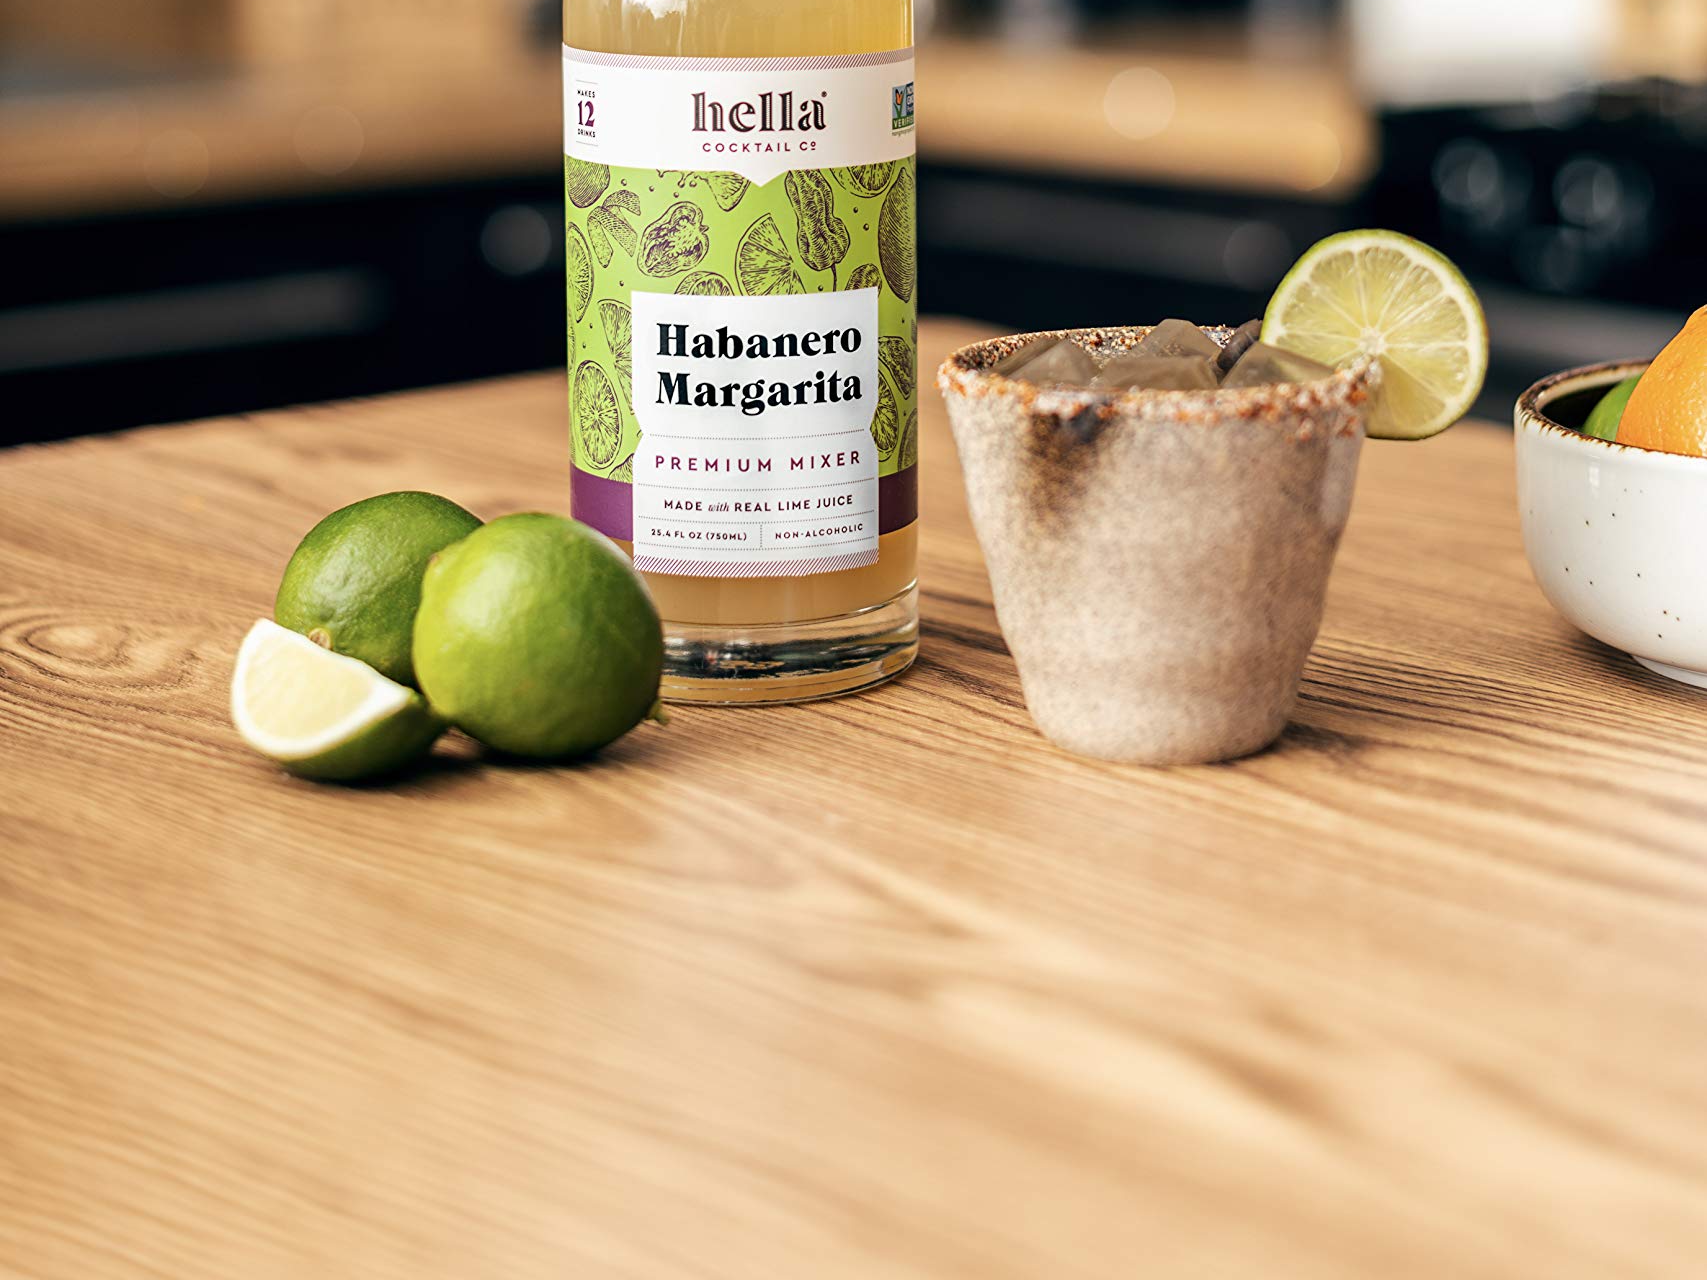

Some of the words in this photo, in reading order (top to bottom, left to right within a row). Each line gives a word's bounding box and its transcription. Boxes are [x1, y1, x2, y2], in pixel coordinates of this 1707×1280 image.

[577, 89, 596, 99] MAKES
[577, 100, 596, 128] 12
[577, 128, 596, 138] DRINKS
[702, 141, 792, 153] COCKTAIL
[655, 322, 863, 360] Habanero
[655, 369, 863, 417] Margarita
[655, 454, 772, 473] PREMIUM
[790, 450, 861, 471] MIXER
[664, 499, 703, 512] MADE
[707, 501, 730, 513] with
[734, 503, 772, 513] REAL
[777, 499, 811, 512] LIME
[816, 494, 854, 510] JUICE
[651, 528, 672, 538] 25.4
[674, 530, 685, 539] FL
[688, 531, 702, 540] OZ
[705, 531, 748, 542] (750ML)
[774, 523, 864, 540] NON-ALCOHOLIC
